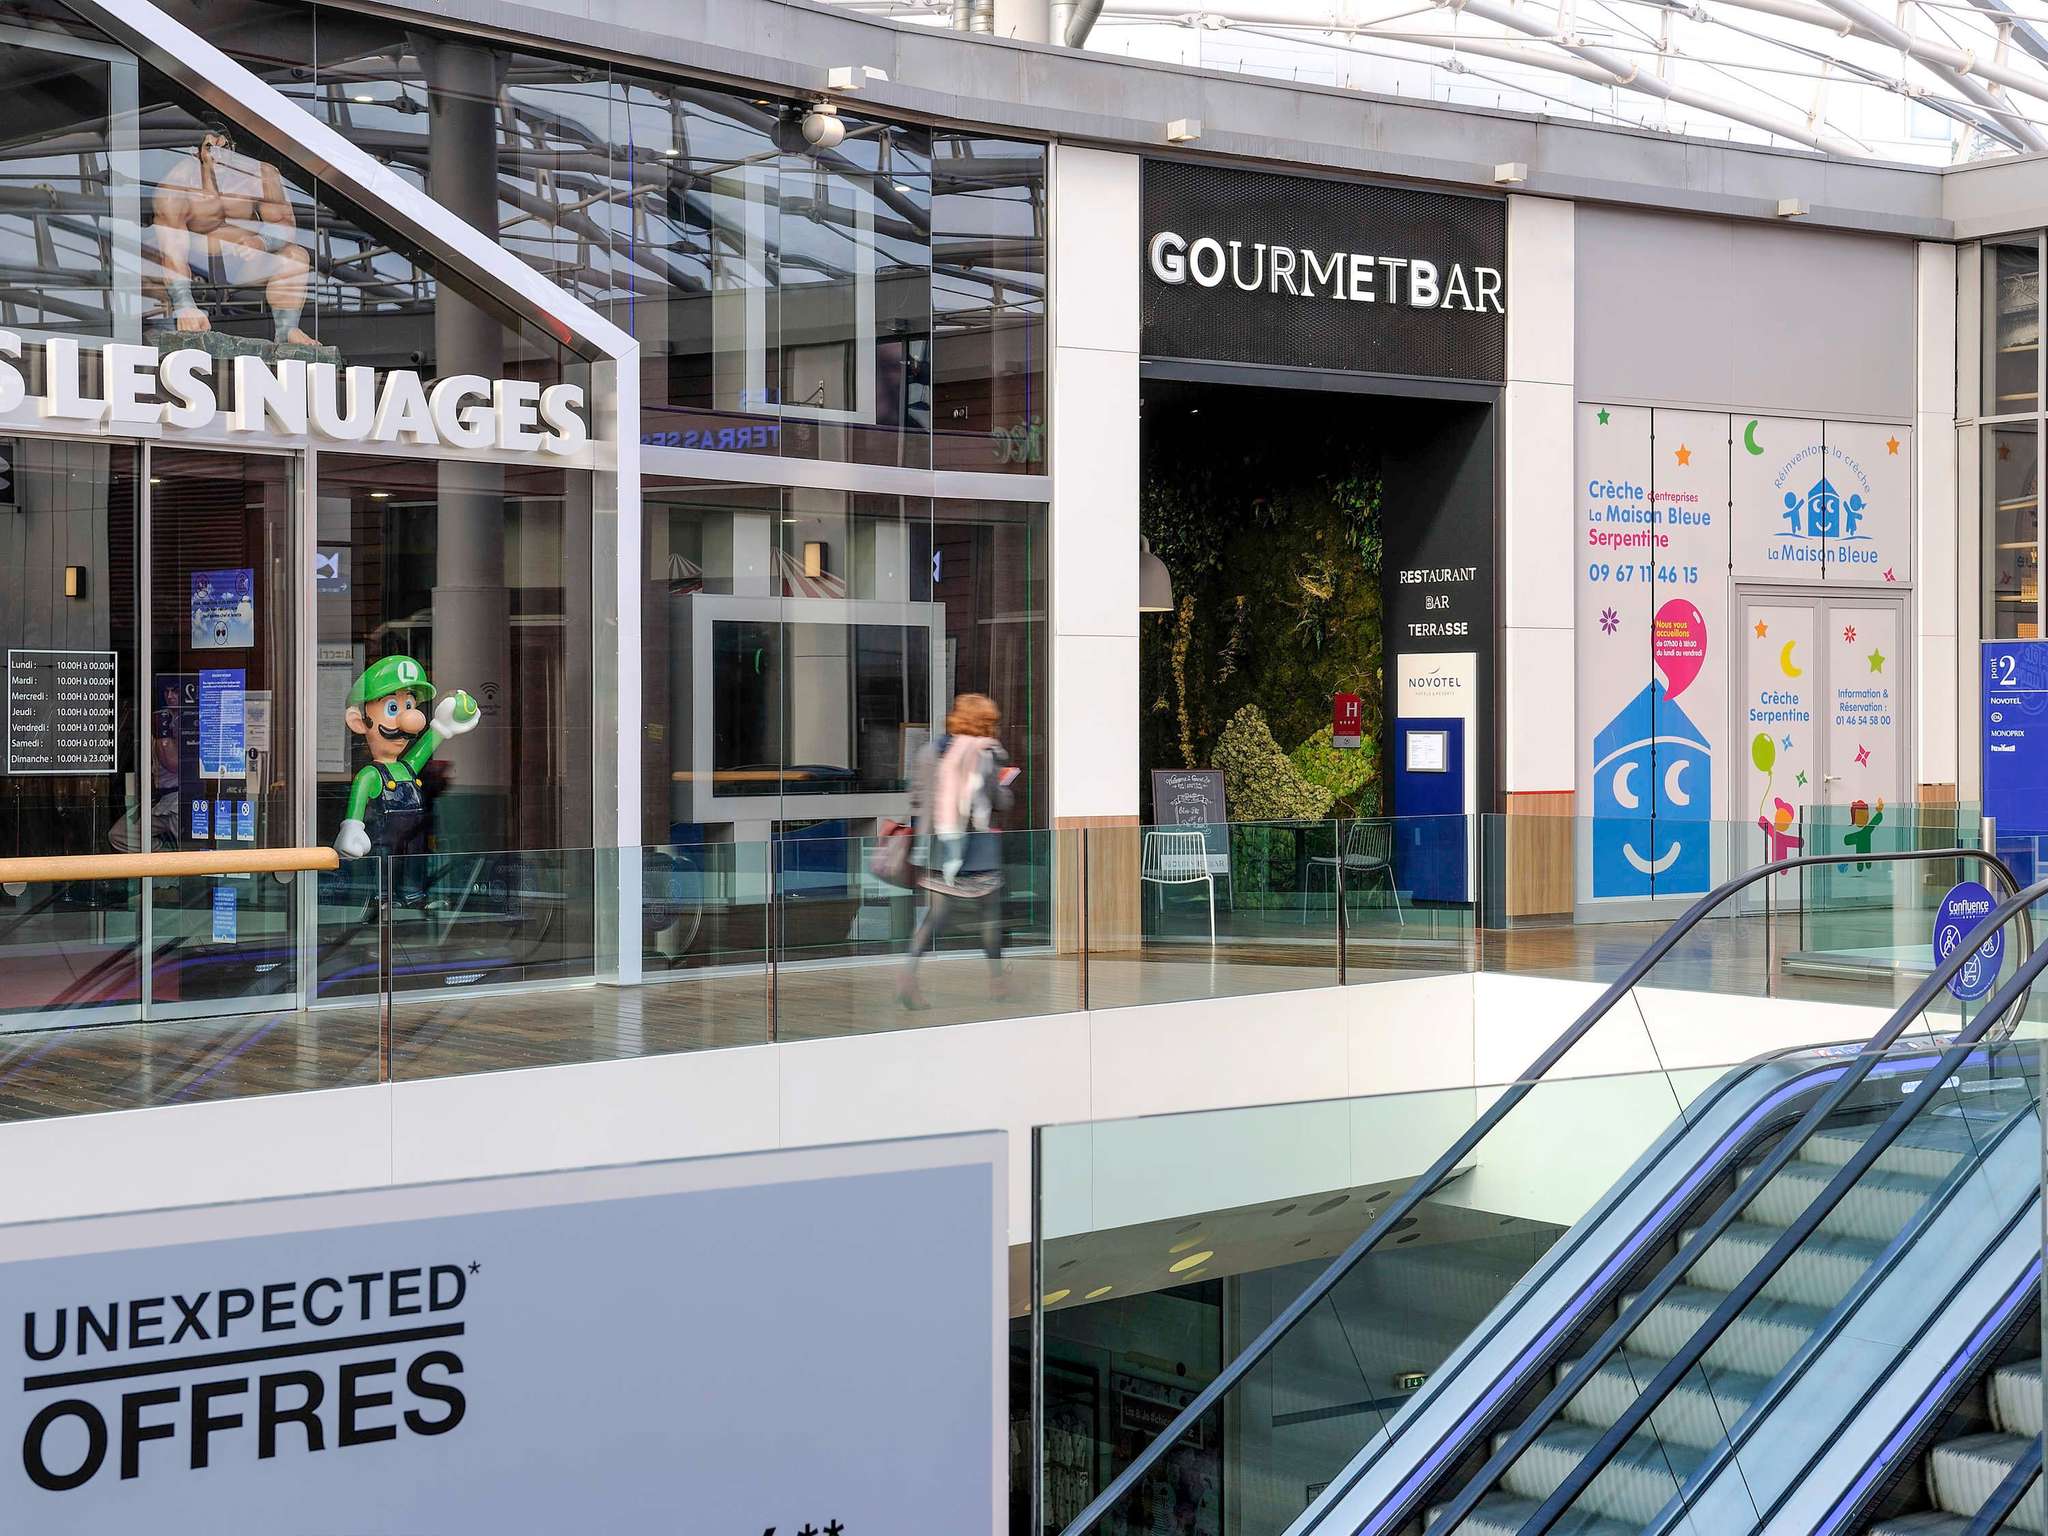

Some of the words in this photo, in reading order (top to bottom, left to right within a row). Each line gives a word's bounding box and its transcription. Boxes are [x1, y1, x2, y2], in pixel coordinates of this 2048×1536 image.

[1148, 230, 1505, 315] GOURMETBAR
[46, 337, 217, 428] LES
[228, 355, 587, 457] NUAGES
[1588, 479, 1644, 500] Crèche
[1647, 491, 1699, 503] dentreprises
[1589, 508, 1602, 521] La
[1606, 504, 1662, 524] Maison
[1668, 506, 1711, 526] Bleue
[1588, 528, 1669, 551] Serpentine
[1768, 547, 1779, 560] La
[1781, 545, 1835, 562] Maison
[1839, 546, 1878, 563] Bleue
[1399, 567, 1477, 584] RESTAURANT
[1589, 563, 1610, 582] 09
[1616, 564, 1634, 582] 67
[1640, 565, 1652, 583] 11
[1658, 566, 1677, 583] 46
[1683, 566, 1698, 584] 15
[1425, 595, 1450, 610] BAR
[1407, 622, 1469, 637] TERRASSE
[11, 661, 33, 669] Lundi
[57, 662, 82, 670] 10.00H
[89, 662, 114, 670] 00.00H
[1990, 658, 1999, 679] pont
[2000, 655, 2017, 686] 2
[11, 677, 34, 685] Mardi
[57, 678, 82, 686] 10.00H
[89, 678, 114, 686] 00.00H
[1408, 677, 1462, 688] NOVOTEL
[11, 692, 44, 700] Mercredi
[57, 692, 82, 700] 10.00H
[89, 693, 114, 701] 00.00H
[1760, 691, 1799, 705] Crèche
[1838, 688, 1881, 698] Information
[1882, 689, 1889, 698] &
[1840, 702, 1883, 712] Réservation
[1990, 696, 2022, 705] NOVOTEL
[11, 708, 32, 716] Jeudi
[57, 708, 82, 716] 10.00H
[89, 709, 114, 717] 00.00H
[1346, 701, 1359, 718] H
[1750, 708, 1810, 725] Serpentine
[1836, 715, 1845, 726] 01
[1845, 715, 1856, 726] 46
[1858, 715, 1868, 726] 54
[1880, 715, 1891, 726] 00
[11, 723, 46, 732] Vendredi
[57, 724, 82, 732] 10.00H
[89, 724, 114, 733] 01.00H
[1991, 729, 2025, 737] MONOPRIX
[11, 739, 40, 747] Samedi
[57, 740, 82, 748] 10.00H
[89, 740, 114, 748] 01.00H
[11, 754, 49, 763] Dimanche
[57, 754, 82, 764] 10.00H
[89, 755, 114, 764] 23.00H
[1948, 899, 1989, 913] Confluence
[22, 1350, 467, 1492] OFFRES
